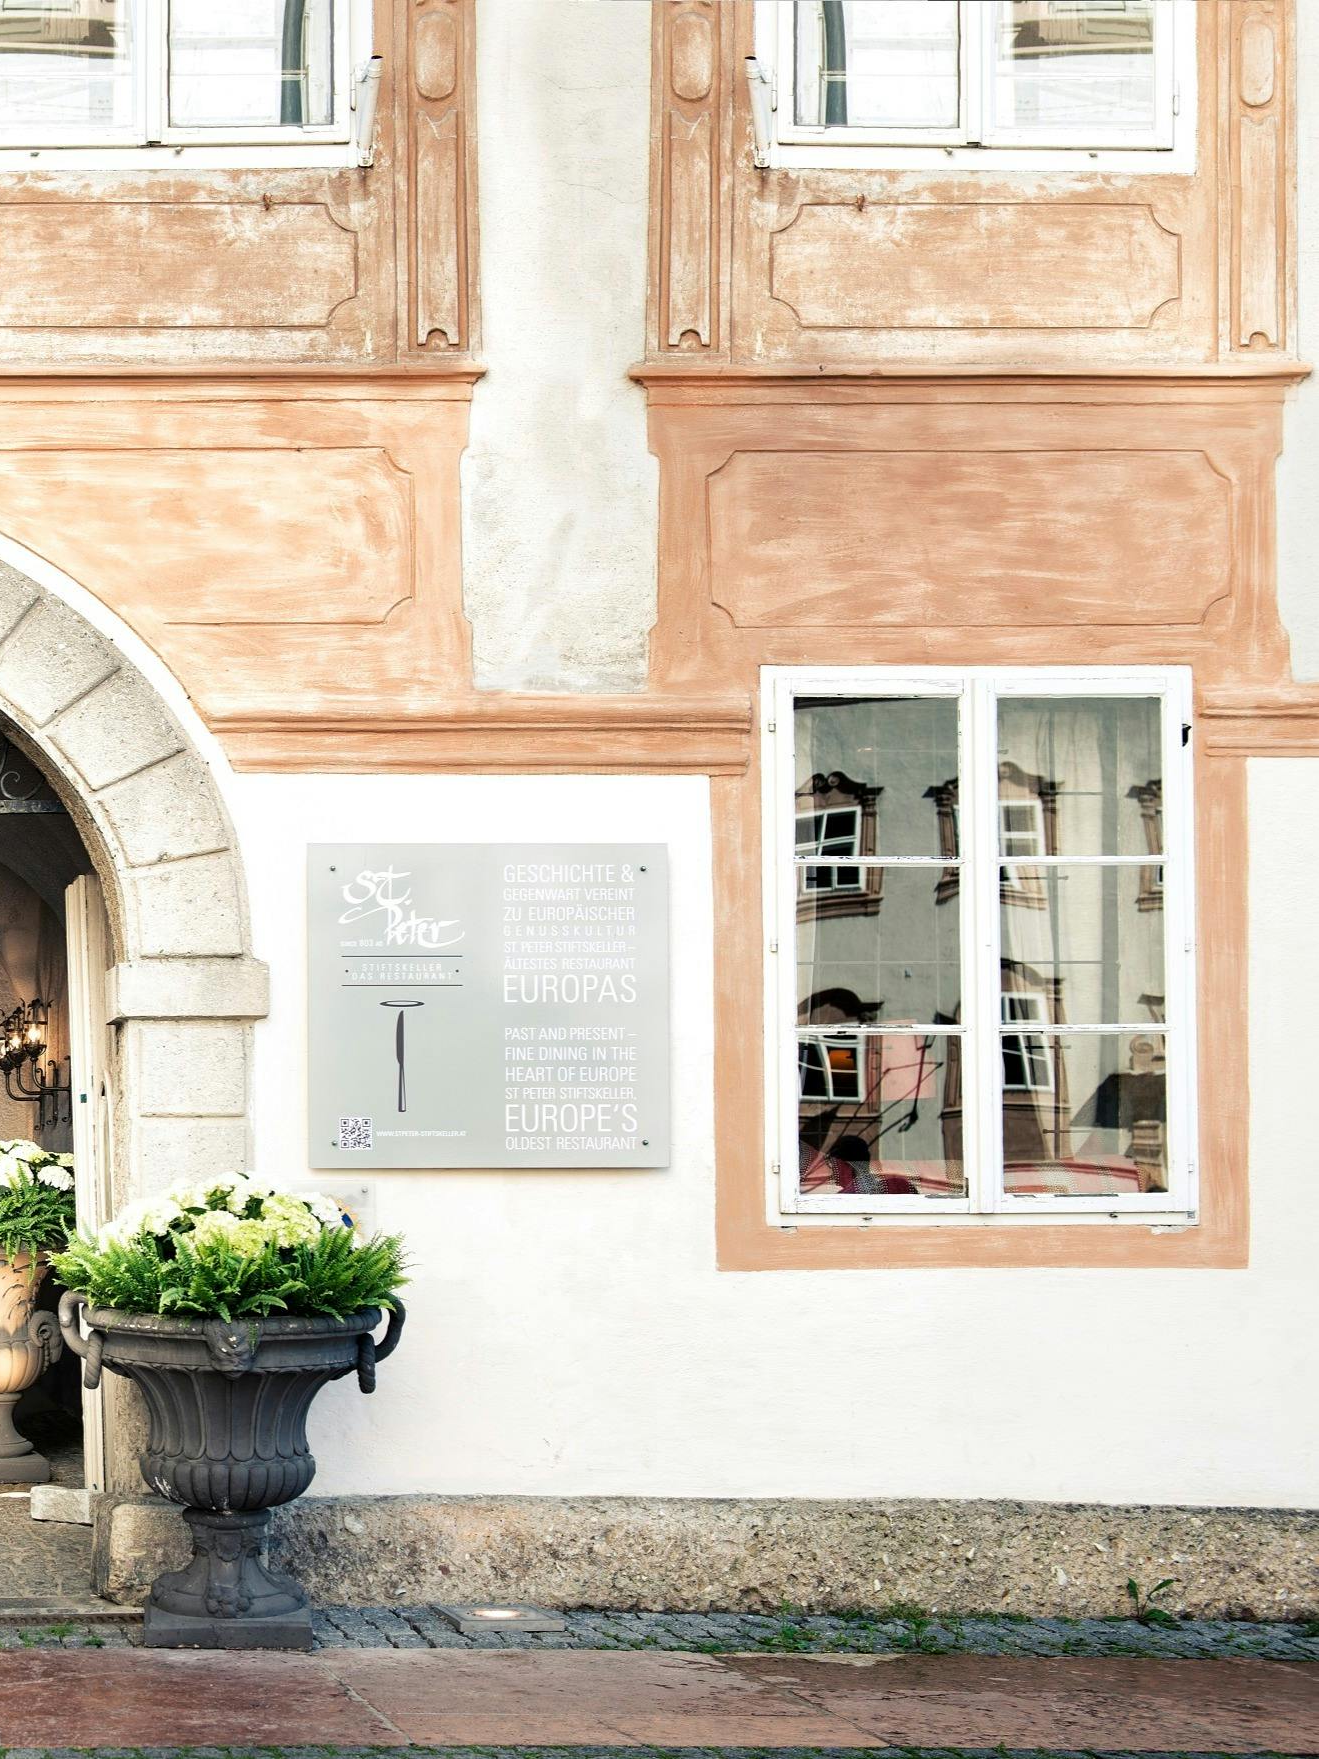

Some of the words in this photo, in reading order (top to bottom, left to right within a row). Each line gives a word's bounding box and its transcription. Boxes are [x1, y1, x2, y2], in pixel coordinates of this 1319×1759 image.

[503, 863, 615, 883] GESCHICHTE
[621, 863, 635, 883] &
[503, 888, 580, 901] GEGENWART
[584, 888, 635, 901] VEREINT
[503, 906, 521, 921] ZU
[528, 904, 635, 921] EUROPÄISCHER
[521, 941, 553, 953] PETER
[554, 941, 626, 953] STIFTSKELLER
[504, 956, 557, 970] ÄLTESTES
[562, 958, 635, 970] RESTAURANT
[380, 972, 453, 980] RESTAURANT
[503, 974, 637, 1003] EUROPAS
[504, 1027, 537, 1040] PAST
[538, 1027, 567, 1040] AND
[569, 1027, 626, 1040] PRESENT
[504, 1046, 535, 1061] FINE
[539, 1046, 588, 1061] DINING
[592, 1046, 607, 1061] IN
[610, 1046, 638, 1061] THE
[505, 1066, 554, 1082] HEART
[557, 1066, 576, 1082] OF
[579, 1066, 638, 1082] EUROPE
[504, 1087, 520, 1100] ST
[522, 1087, 556, 1100] PETER
[505, 1103, 638, 1132] EUROPE'S
[505, 1136, 553, 1150] OLDEST
[556, 1136, 637, 1150] RESTAURANT
